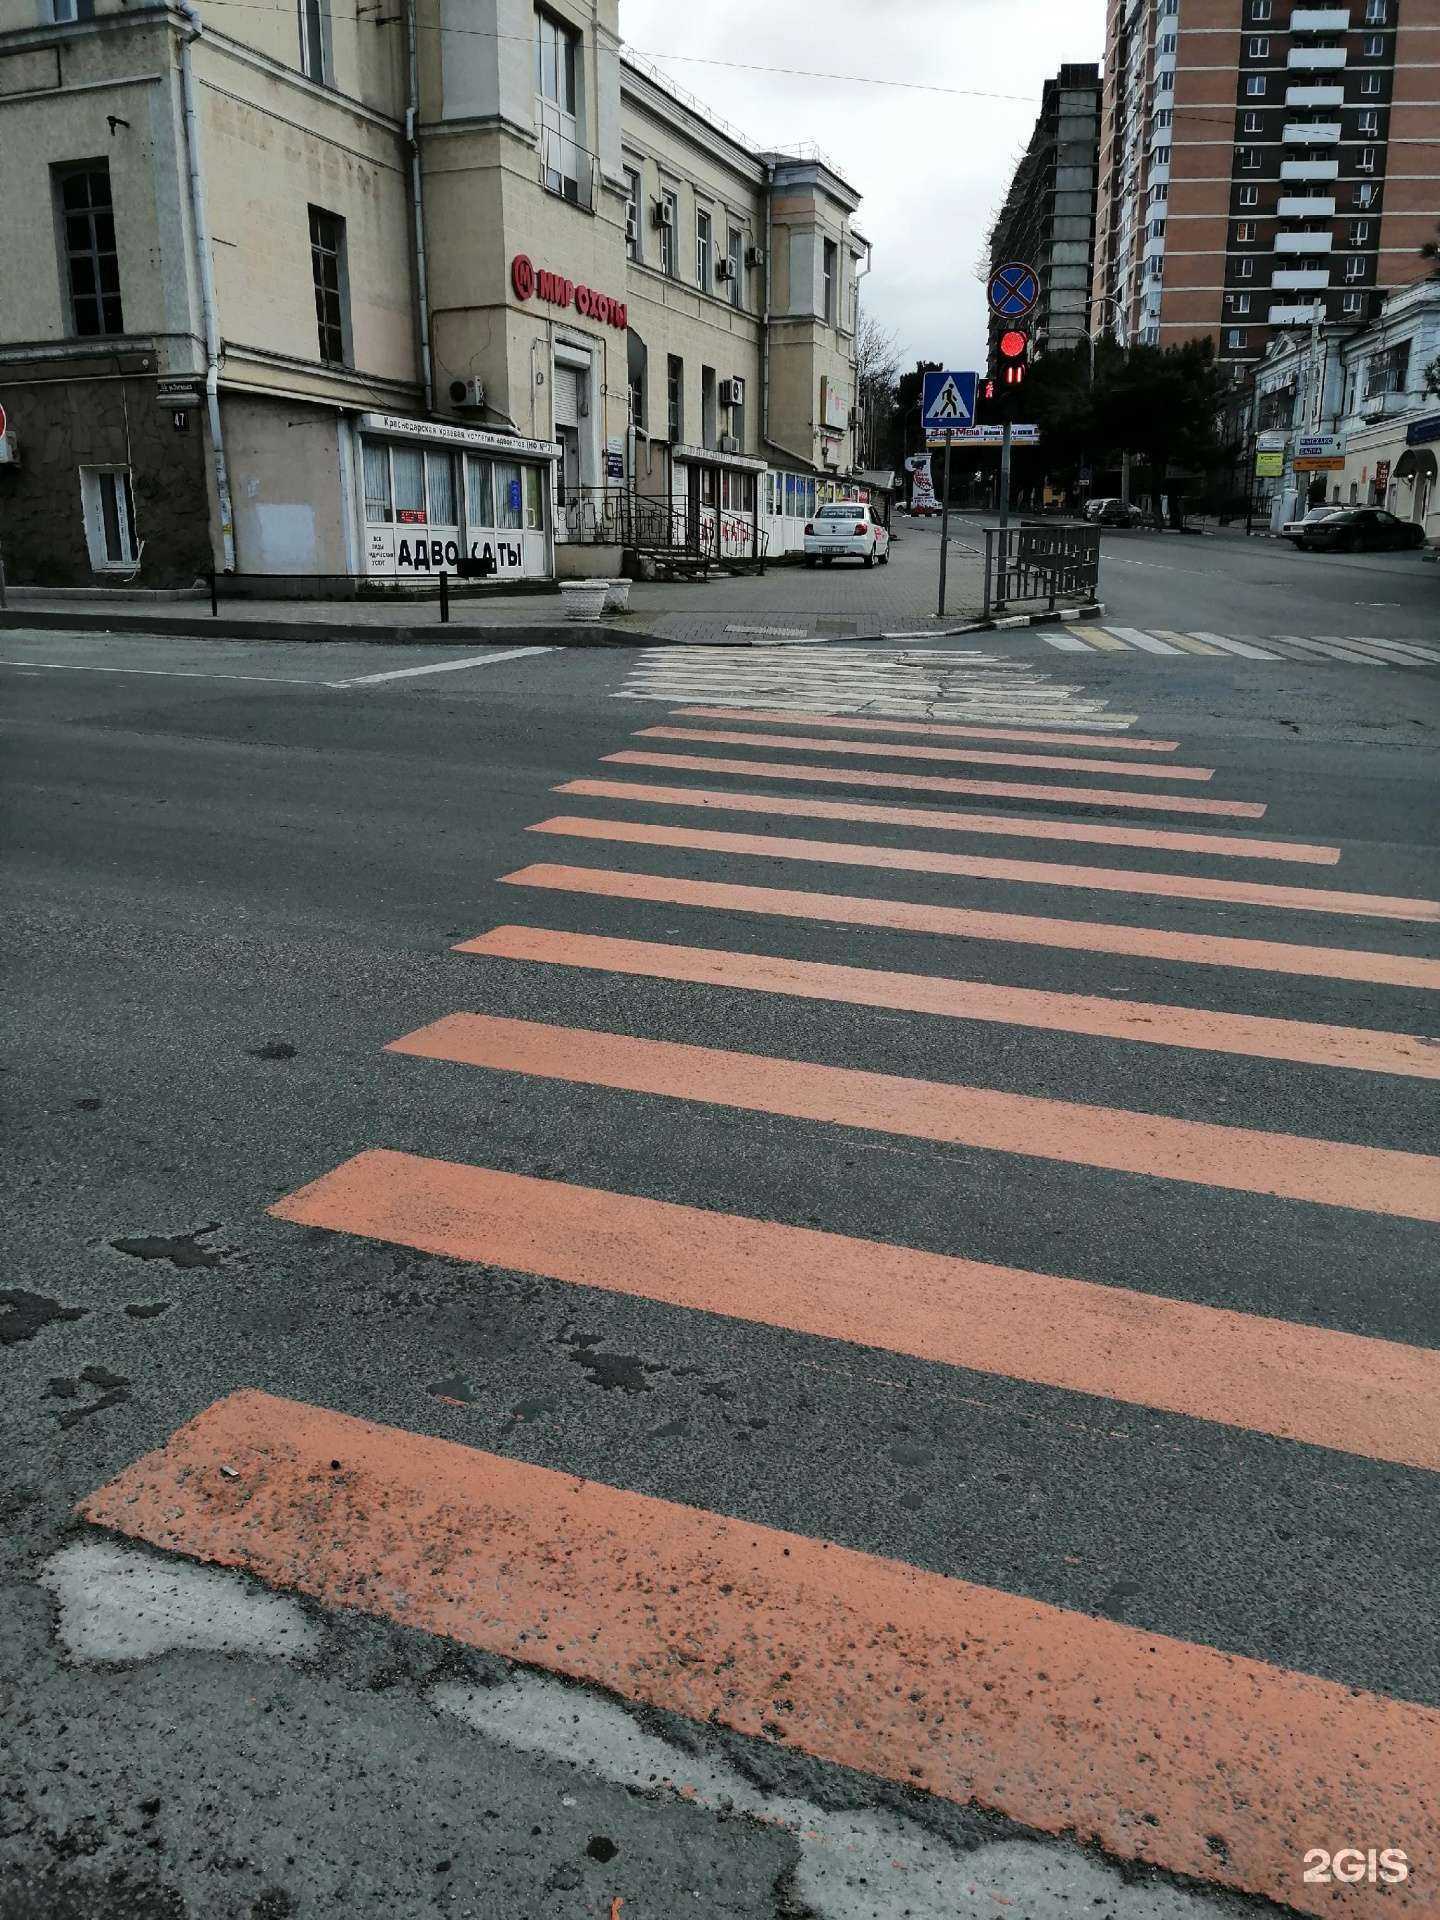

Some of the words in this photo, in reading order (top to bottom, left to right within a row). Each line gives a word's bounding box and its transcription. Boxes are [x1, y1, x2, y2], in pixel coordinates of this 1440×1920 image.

[537, 268, 575, 308] МИР
[575, 285, 628, 330] ОХОТЫ
[174, 412, 185, 426] 47
